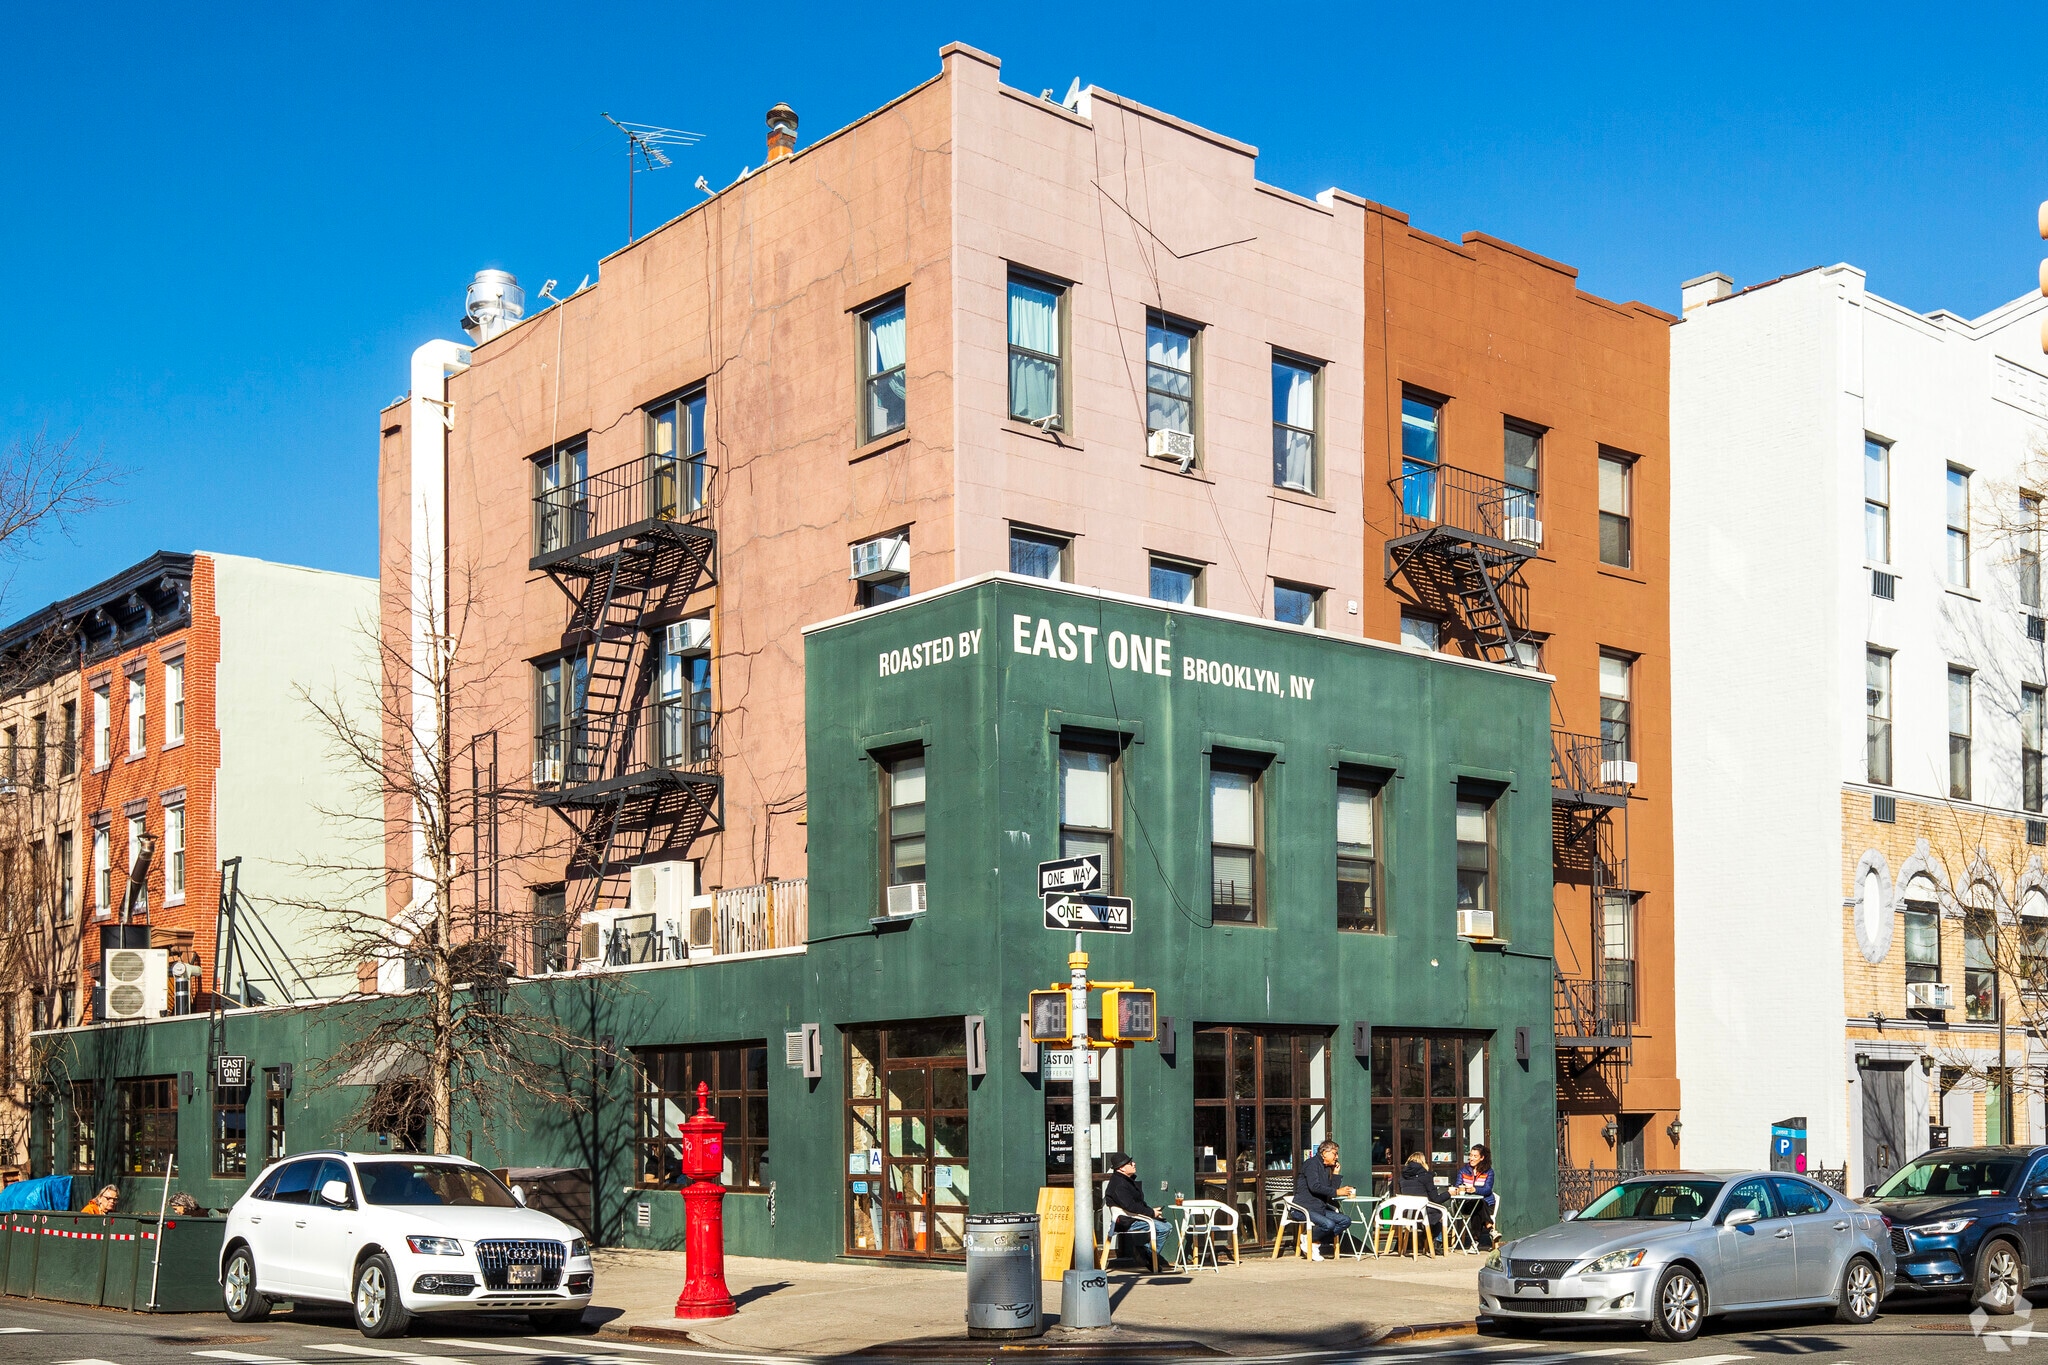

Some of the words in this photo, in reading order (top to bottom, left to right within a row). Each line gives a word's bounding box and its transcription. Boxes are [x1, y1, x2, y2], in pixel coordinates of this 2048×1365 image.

[879, 636, 954, 677] ROASTED
[959, 628, 982, 658] BY
[1013, 614, 1098, 664] EAST
[1108, 630, 1171, 677] ONE
[1183, 656, 1285, 698] BROOKLYN,
[1290, 675, 1315, 700] NY
[1047, 871, 1065, 886] ONE
[1073, 867, 1092, 882] WAY
[1057, 905, 1083, 919] ONE
[1097, 907, 1124, 922] WAY
[221, 1059, 243, 1068] EAST
[1063, 1054, 1074, 1065] ON
[223, 1068, 241, 1077] ONE
[1050, 1124, 1074, 1132] EATERY
[1780, 1139, 1790, 1154] P
[871, 1152, 881, 1165] A
